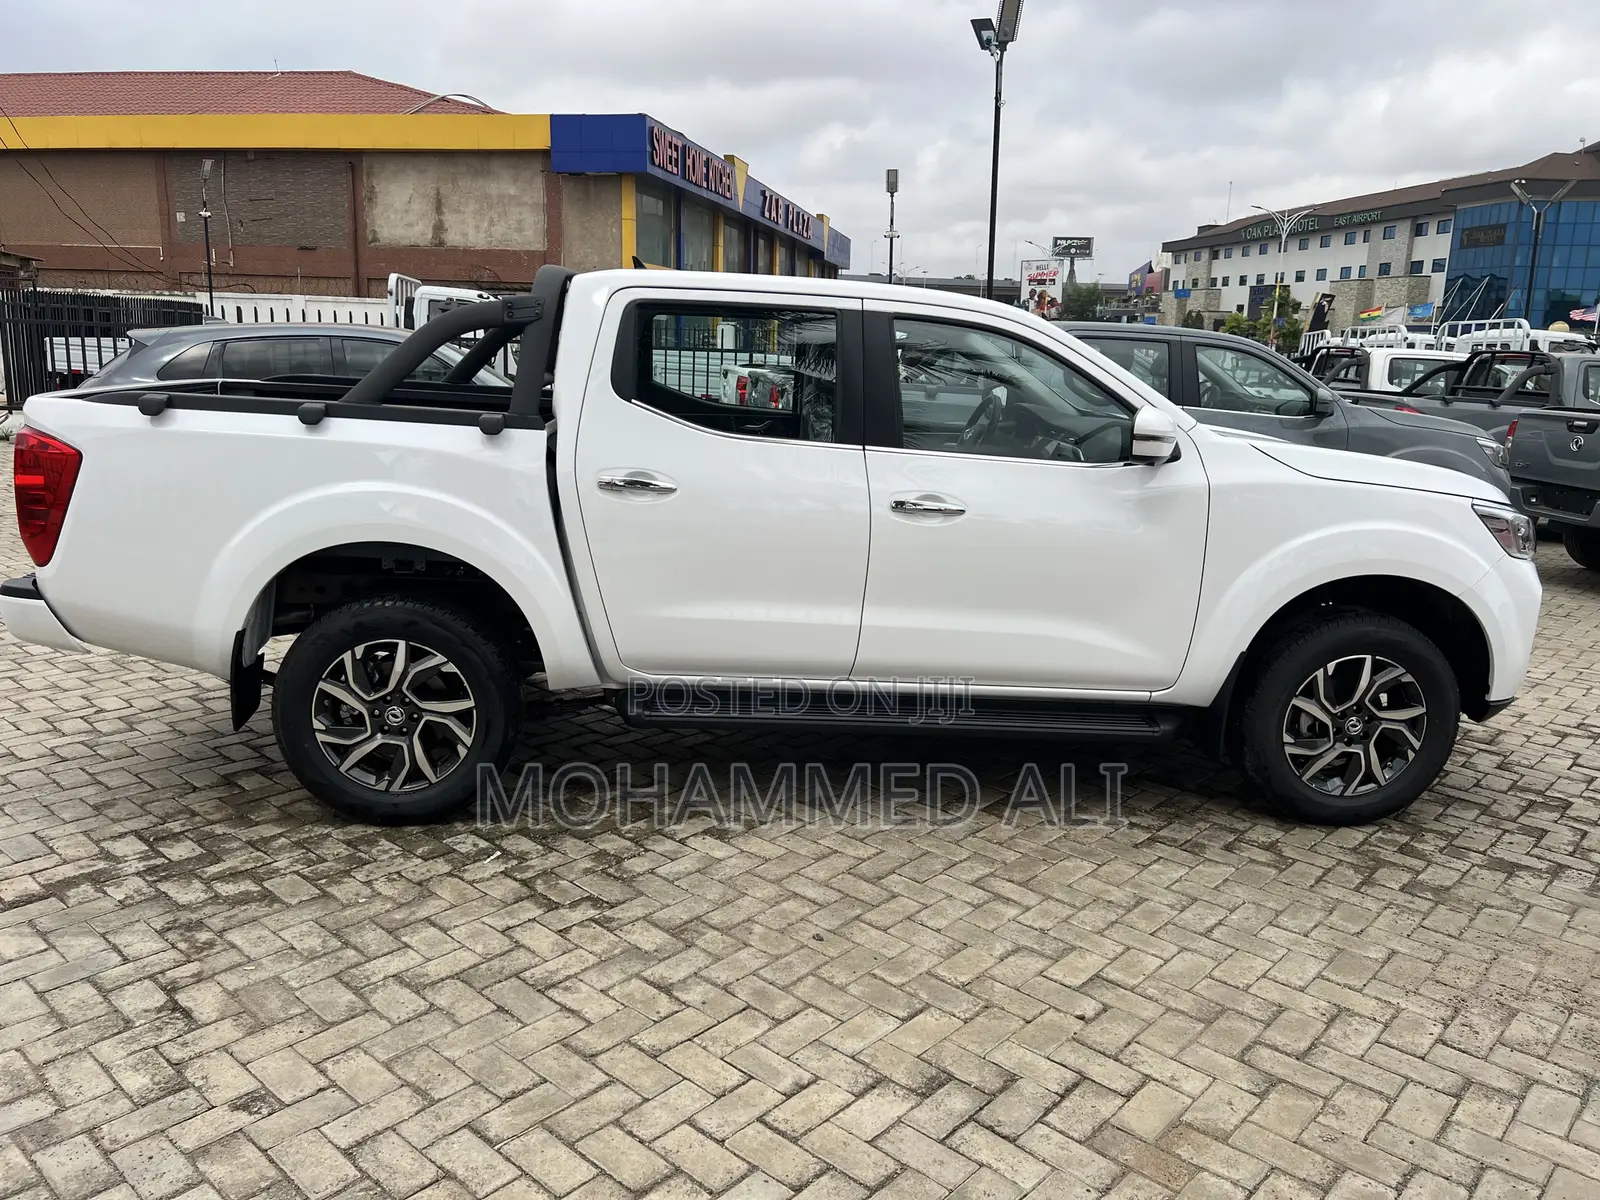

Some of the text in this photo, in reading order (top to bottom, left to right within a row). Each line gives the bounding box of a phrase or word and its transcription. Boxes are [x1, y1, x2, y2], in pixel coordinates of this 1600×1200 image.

[653, 126, 734, 199] SWEET HOME KITCHEN
[763, 189, 813, 240] ZAB PLAZA
[1334, 210, 1382, 226] EAST AIRPORT
[1246, 227, 1263, 239] OAK
[1291, 217, 1319, 233] HOTEL
[1027, 268, 1059, 279] SUMMER
